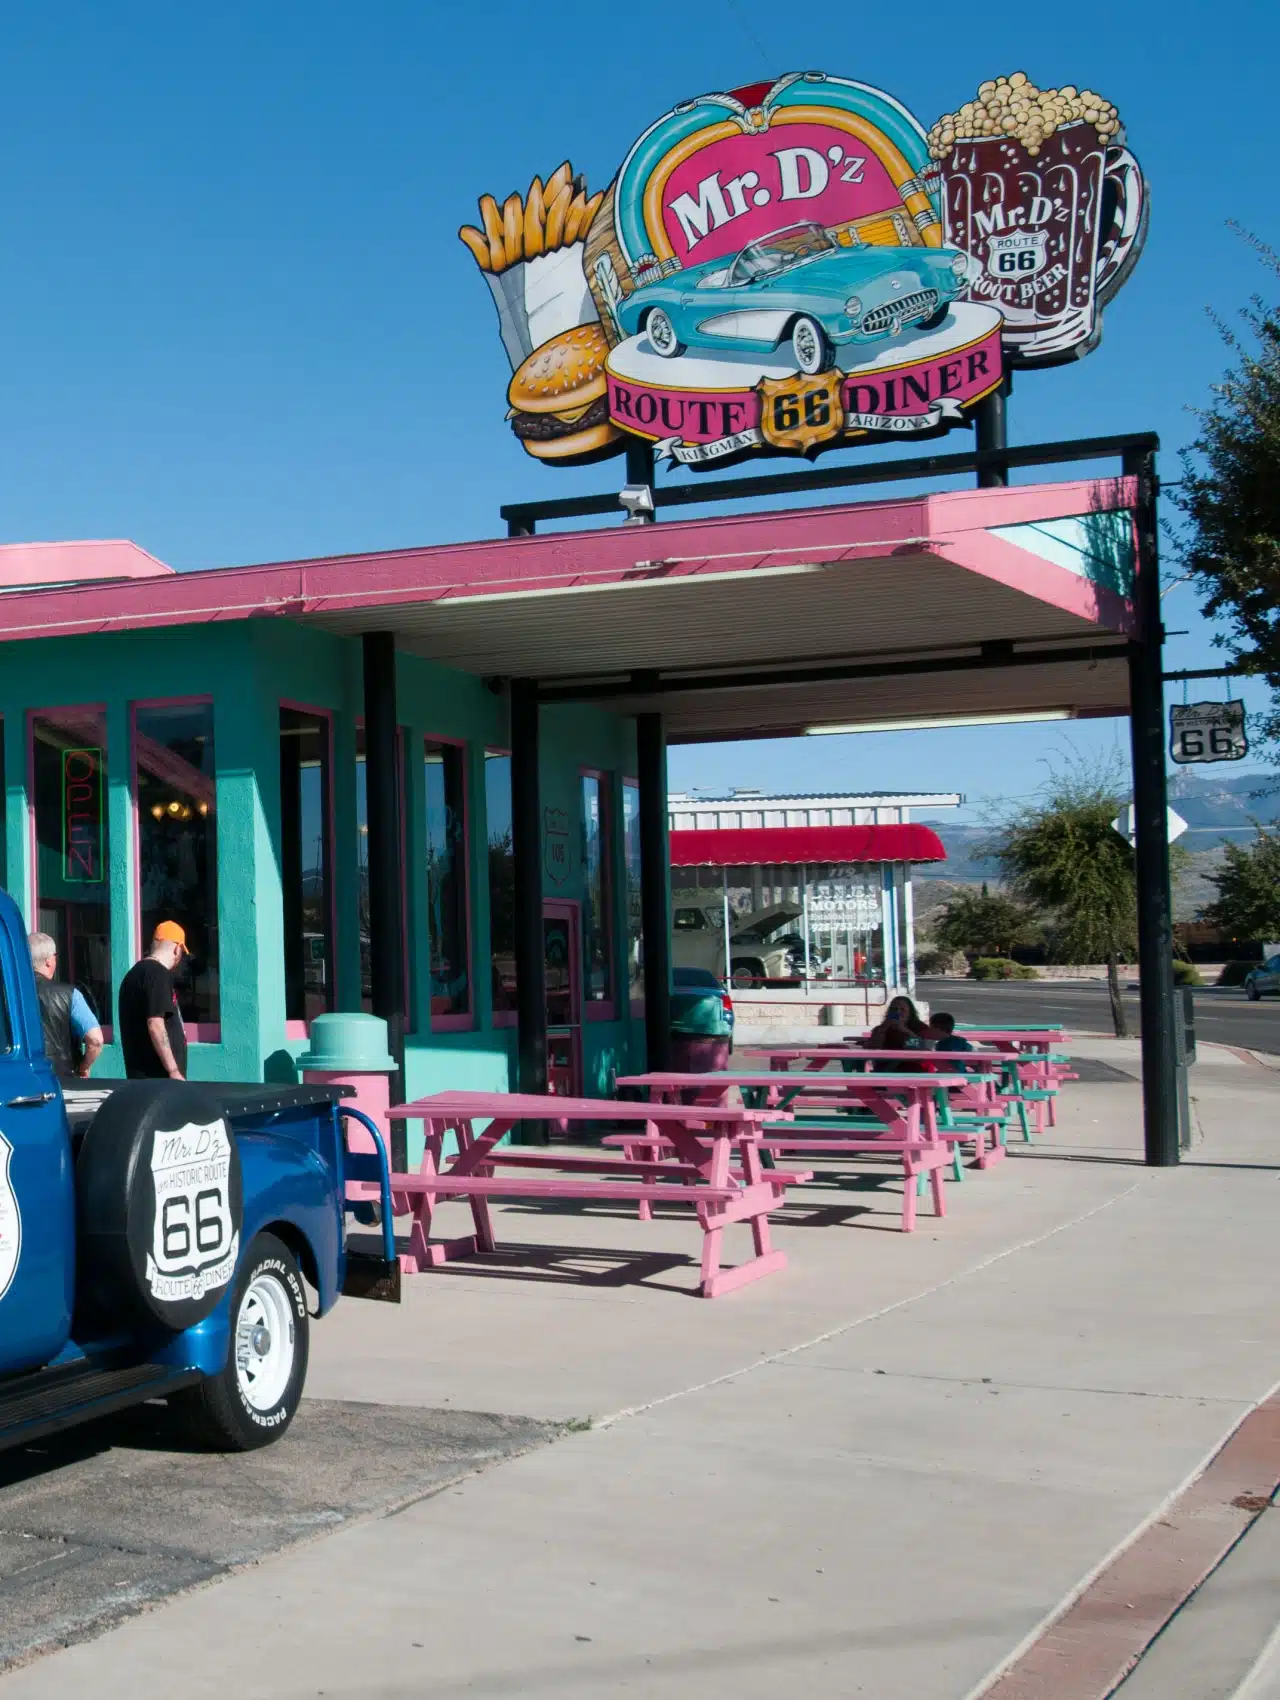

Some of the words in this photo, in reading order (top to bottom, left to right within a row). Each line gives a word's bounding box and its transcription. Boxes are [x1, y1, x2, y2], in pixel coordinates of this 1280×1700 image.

[668, 170, 771, 254] Mr.
[767, 145, 867, 202] D'z
[972, 202, 1026, 239] Mr.
[998, 237, 1038, 248] ROUTE
[999, 250, 1036, 272] 66
[971, 275, 1017, 300] ROOT
[1020, 263, 1069, 299] BEER
[614, 387, 747, 436] ROUTE
[773, 389, 830, 432] 66
[847, 350, 990, 415] DINER
[681, 432, 754, 462] KINGMAN
[850, 413, 931, 430] ARIZONA
[1181, 728, 1232, 756] 66
[66, 751, 94, 877] OPEN
[810, 900, 878, 911] MOTORS
[161, 1136, 191, 1164] Mr.
[169, 1168, 203, 1189] HISTORIC
[204, 1161, 227, 1184] ROUTE
[162, 1188, 223, 1259] 66
[155, 1279, 191, 1296] ROUTE
[193, 1281, 203, 1295] 66
[250, 1259, 286, 1284] RADIAL
[287, 1272, 306, 1317] SR70
